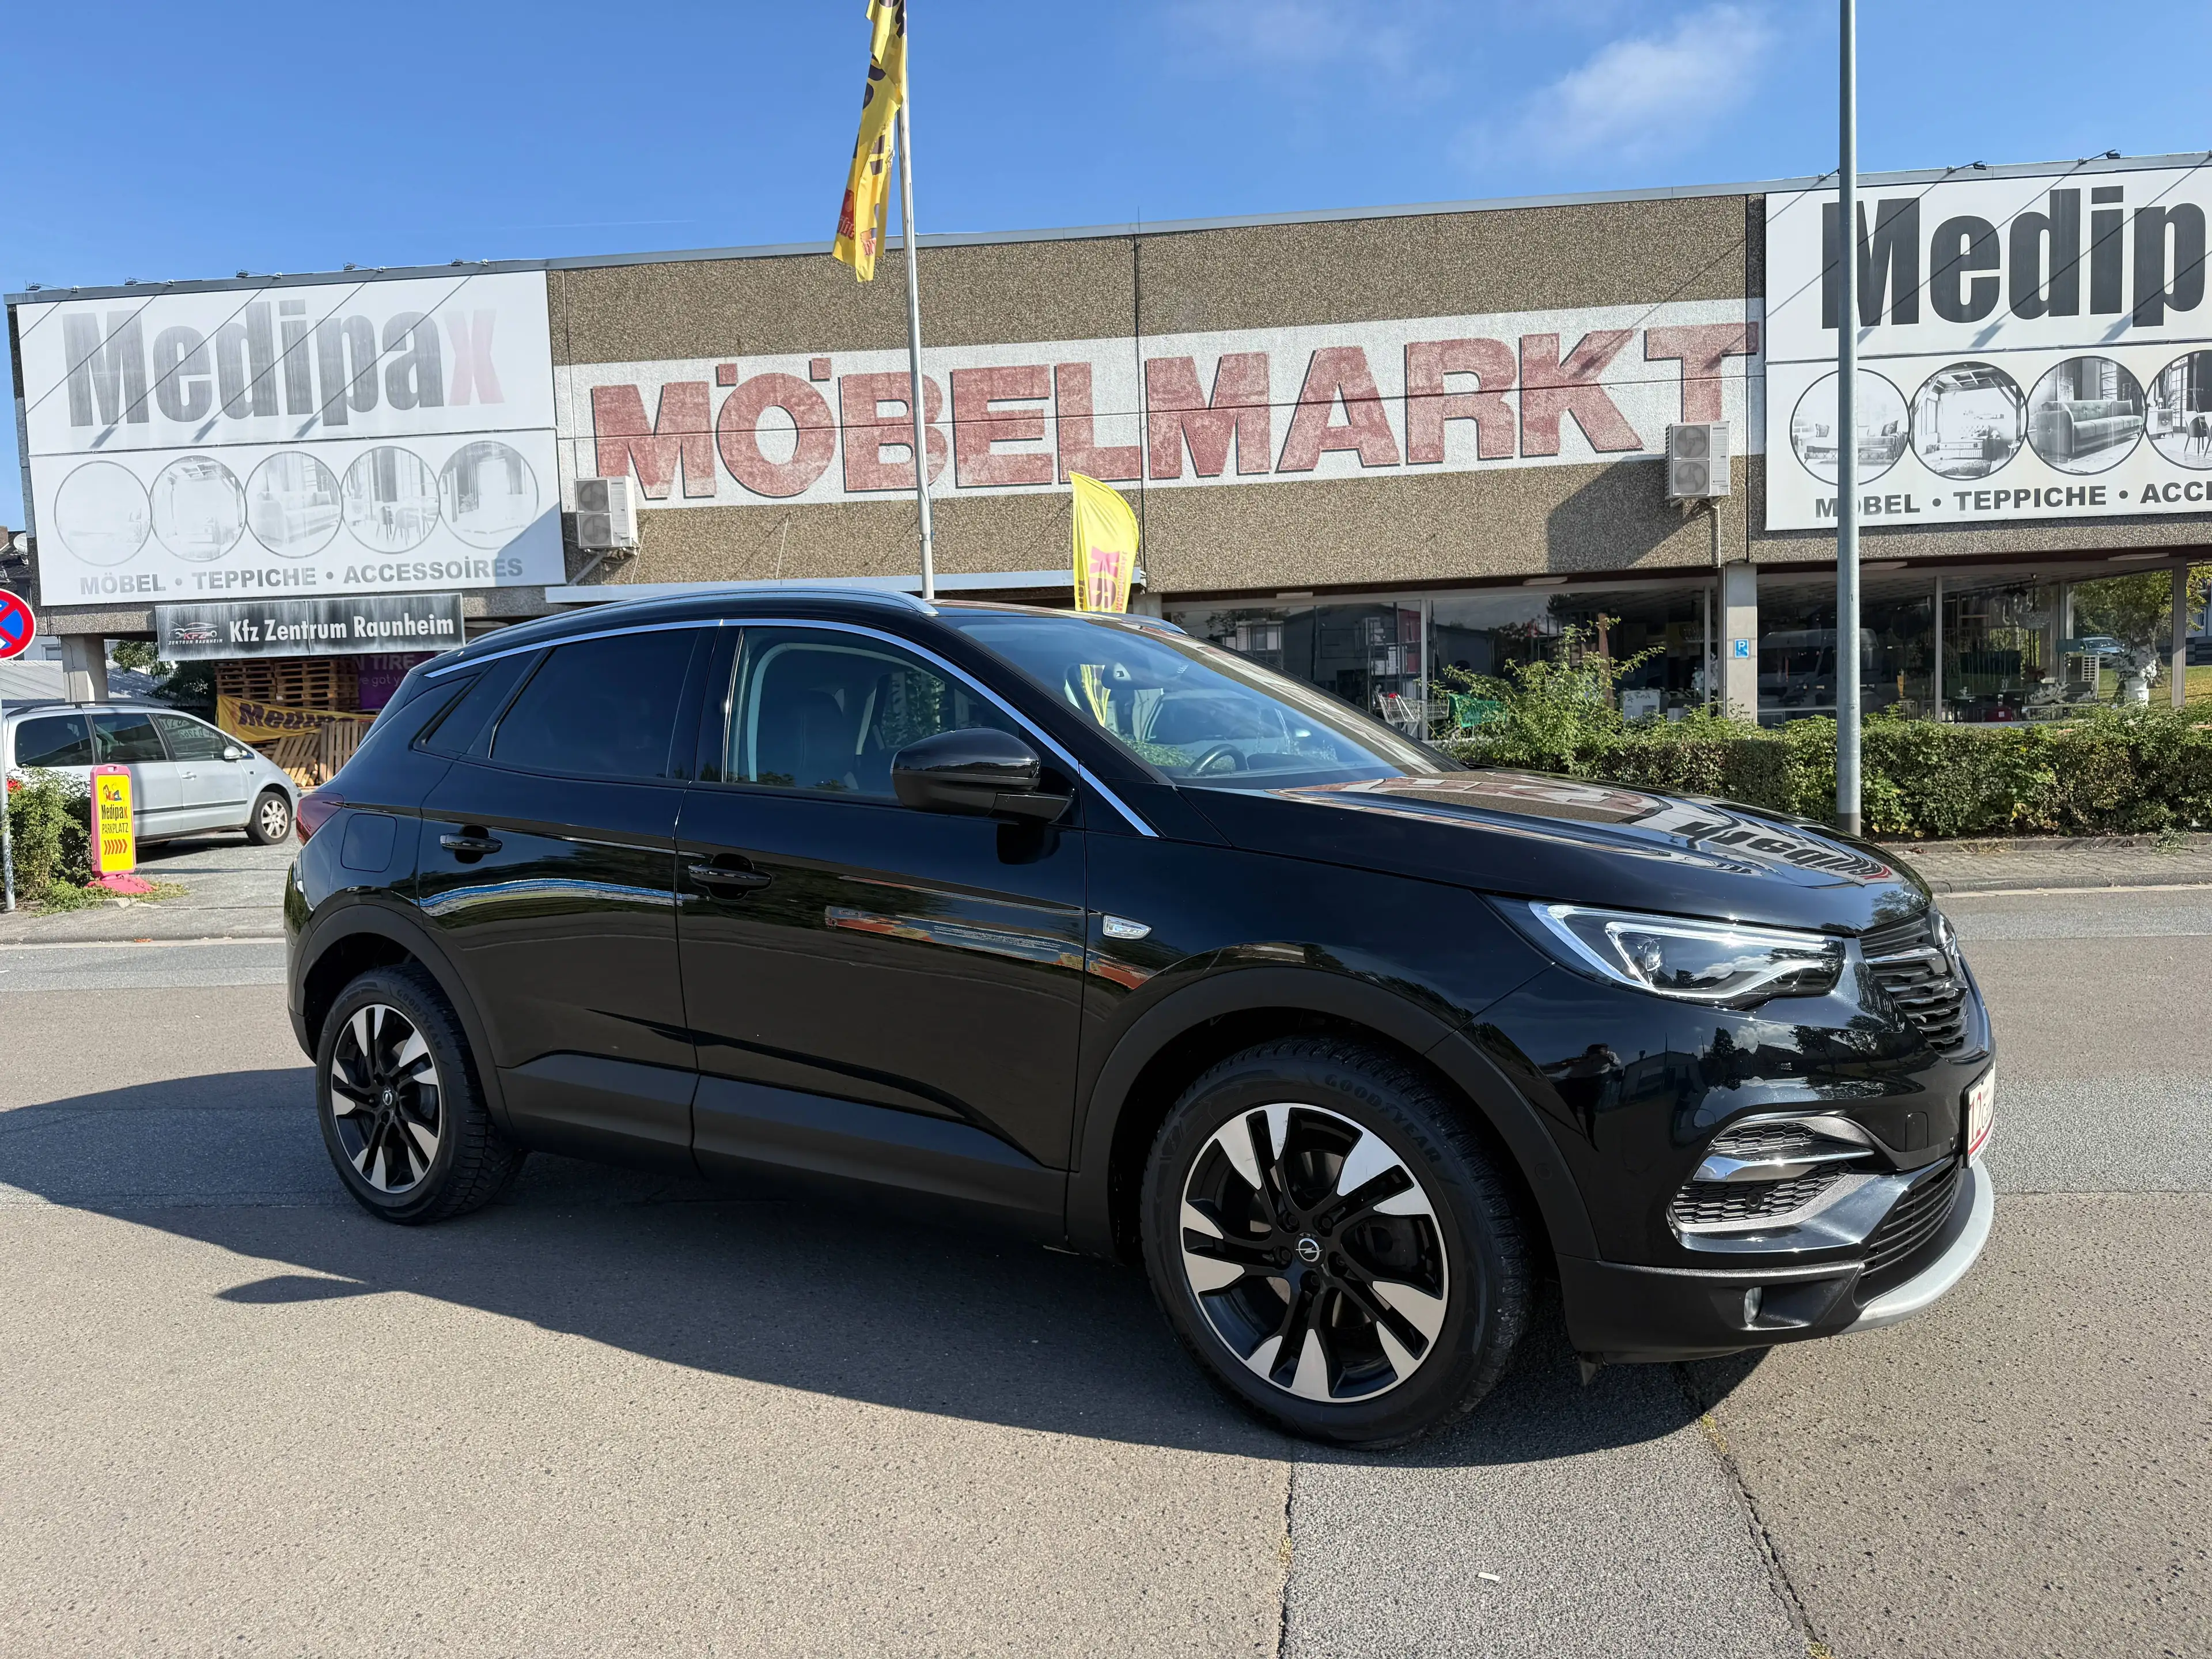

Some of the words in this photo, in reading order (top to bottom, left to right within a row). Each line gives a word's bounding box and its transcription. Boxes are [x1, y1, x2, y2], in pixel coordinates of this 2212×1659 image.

[1822, 185, 2206, 329] Medip
[62, 299, 506, 427] Medipax
[592, 321, 1759, 499] MÖBELMARKT
[1816, 494, 1921, 518] MBEL
[1953, 486, 2107, 512] TEPPICHE
[80, 573, 166, 595] MÖBEL
[192, 567, 316, 590] TEPPICHE
[230, 619, 260, 643] Kfz
[264, 619, 347, 642] Zentrum
[353, 612, 454, 638] Raunheim
[369, 654, 415, 671] TIRE
[372, 674, 392, 687] got
[101, 804, 128, 821] Medipax
[101, 823, 129, 834] PARKPLATZ
[1324, 1073, 1442, 1163] GOODYEAR
